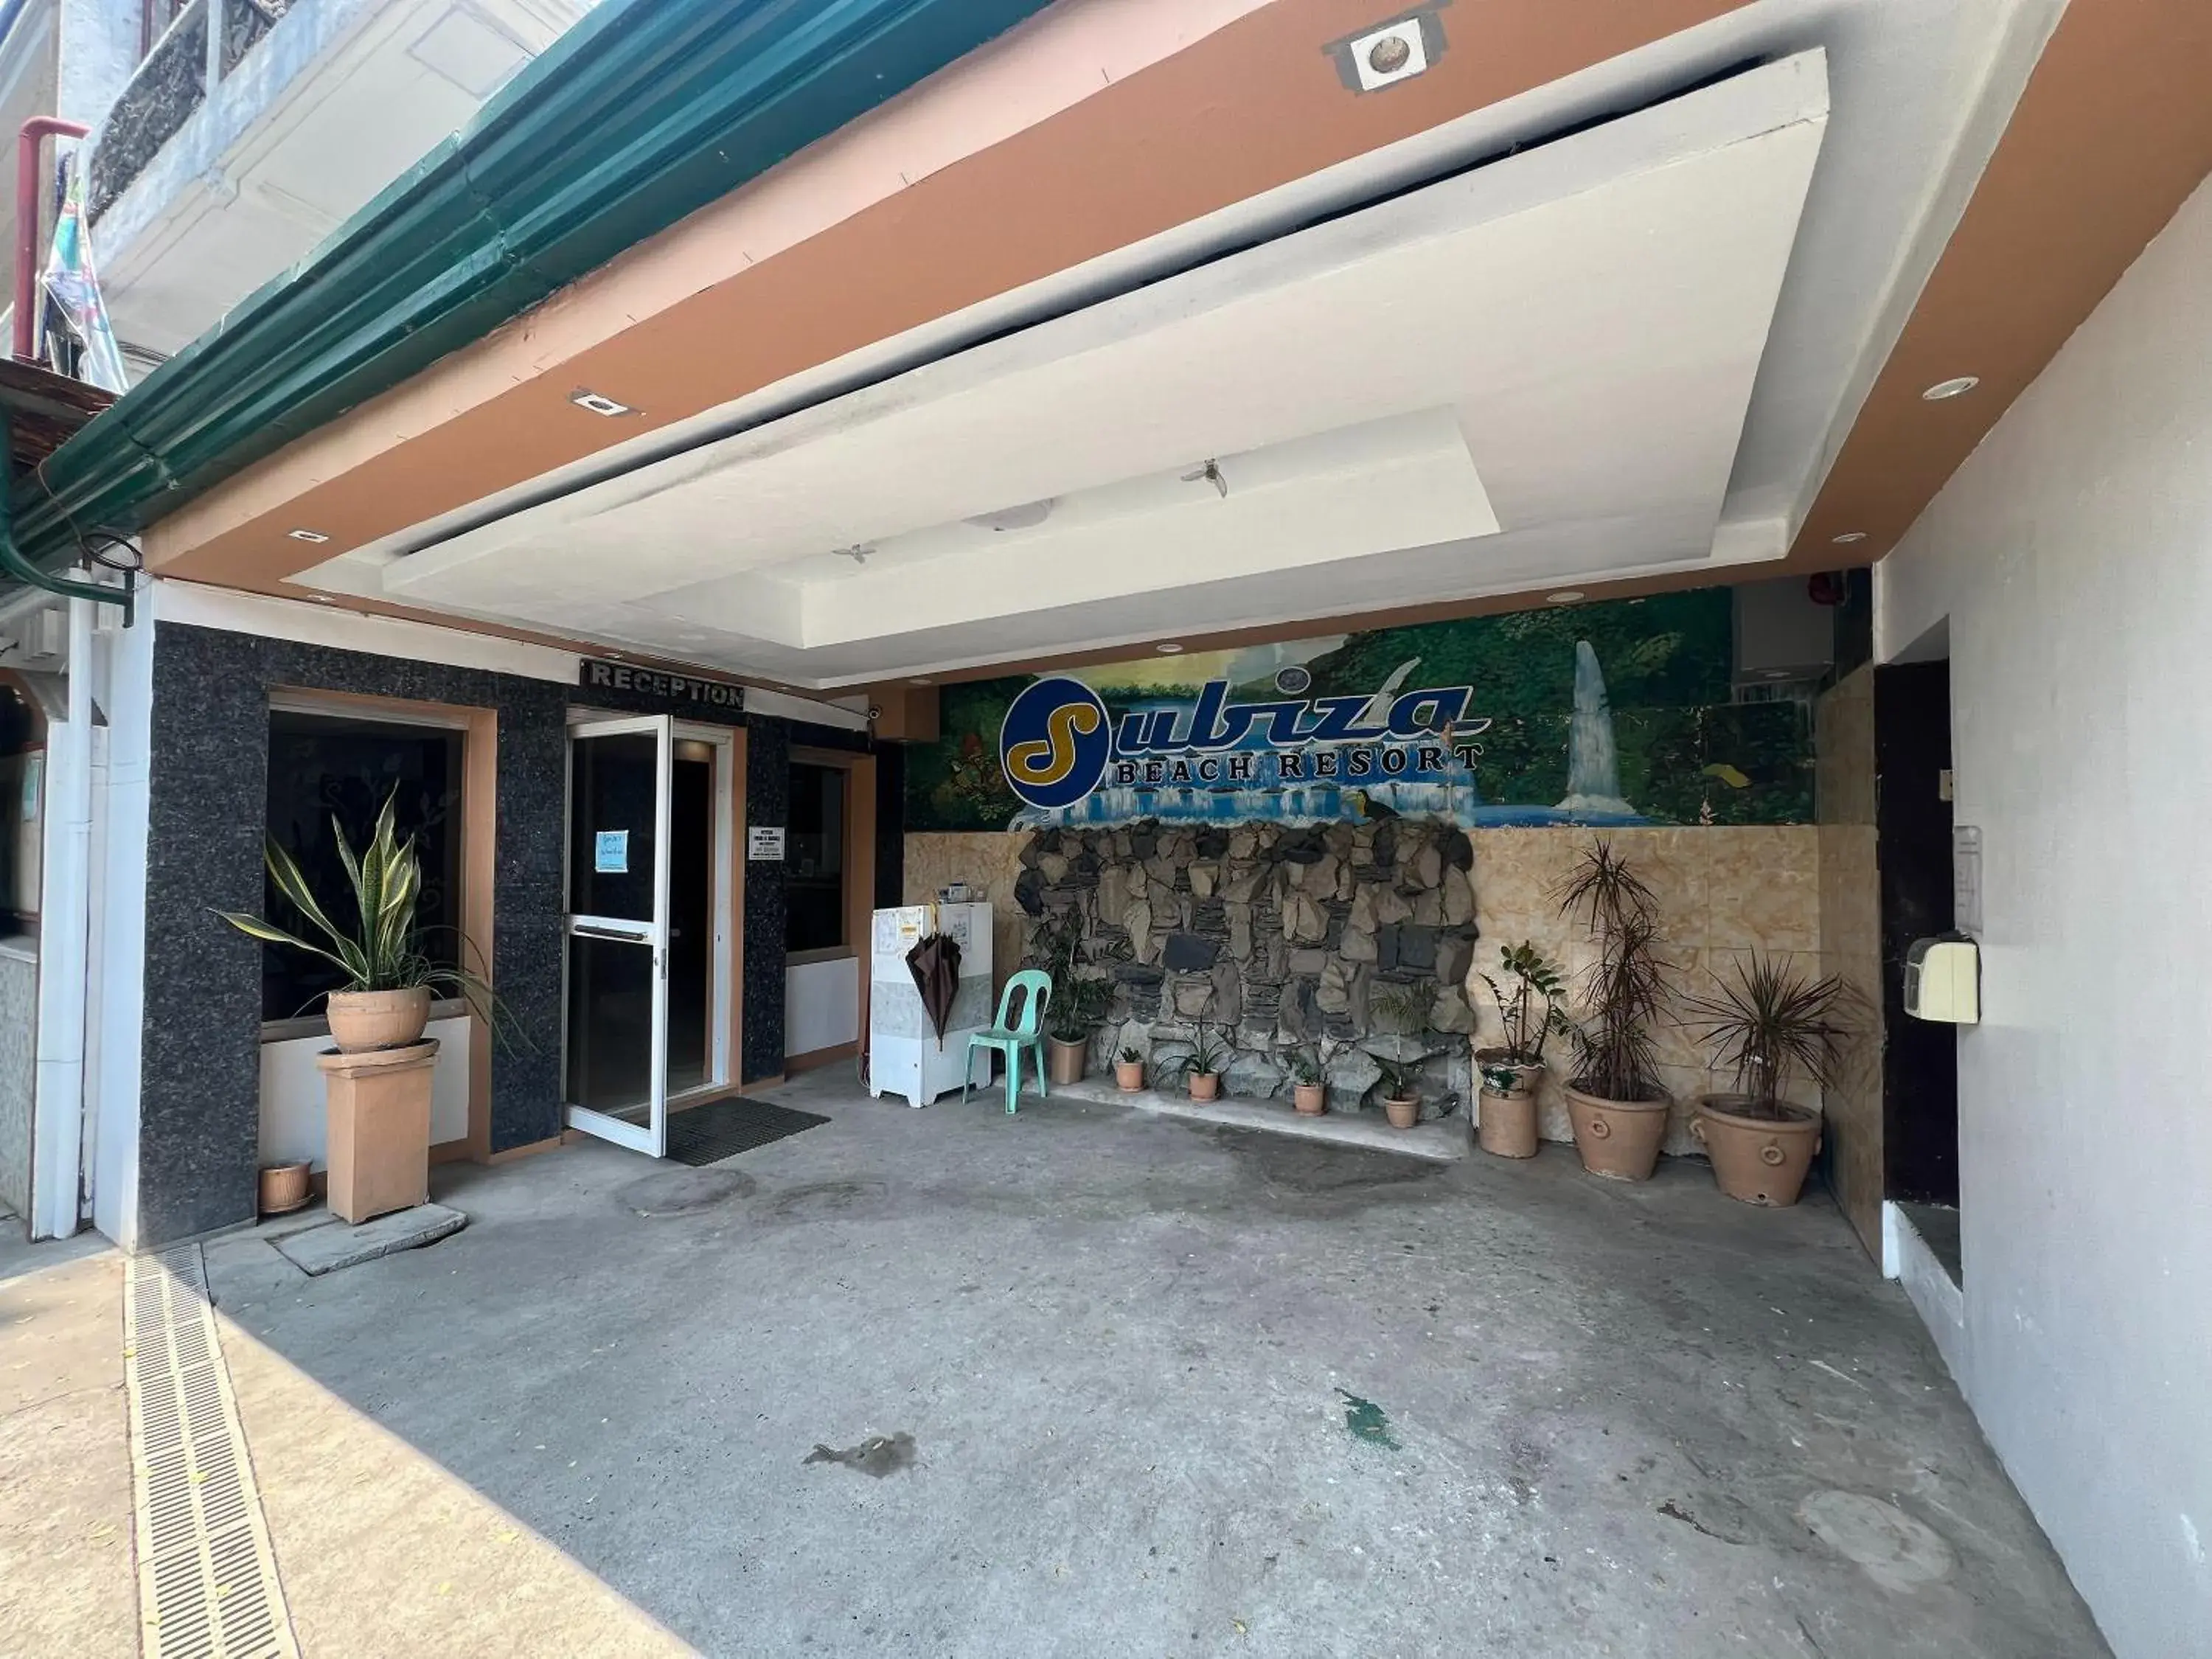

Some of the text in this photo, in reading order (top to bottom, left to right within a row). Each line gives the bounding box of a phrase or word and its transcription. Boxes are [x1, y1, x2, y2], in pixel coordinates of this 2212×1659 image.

[591, 662, 744, 707] RECEPTION
[1004, 658, 1492, 786] Subiza
[1116, 744, 1484, 785] BEACH RESORT
